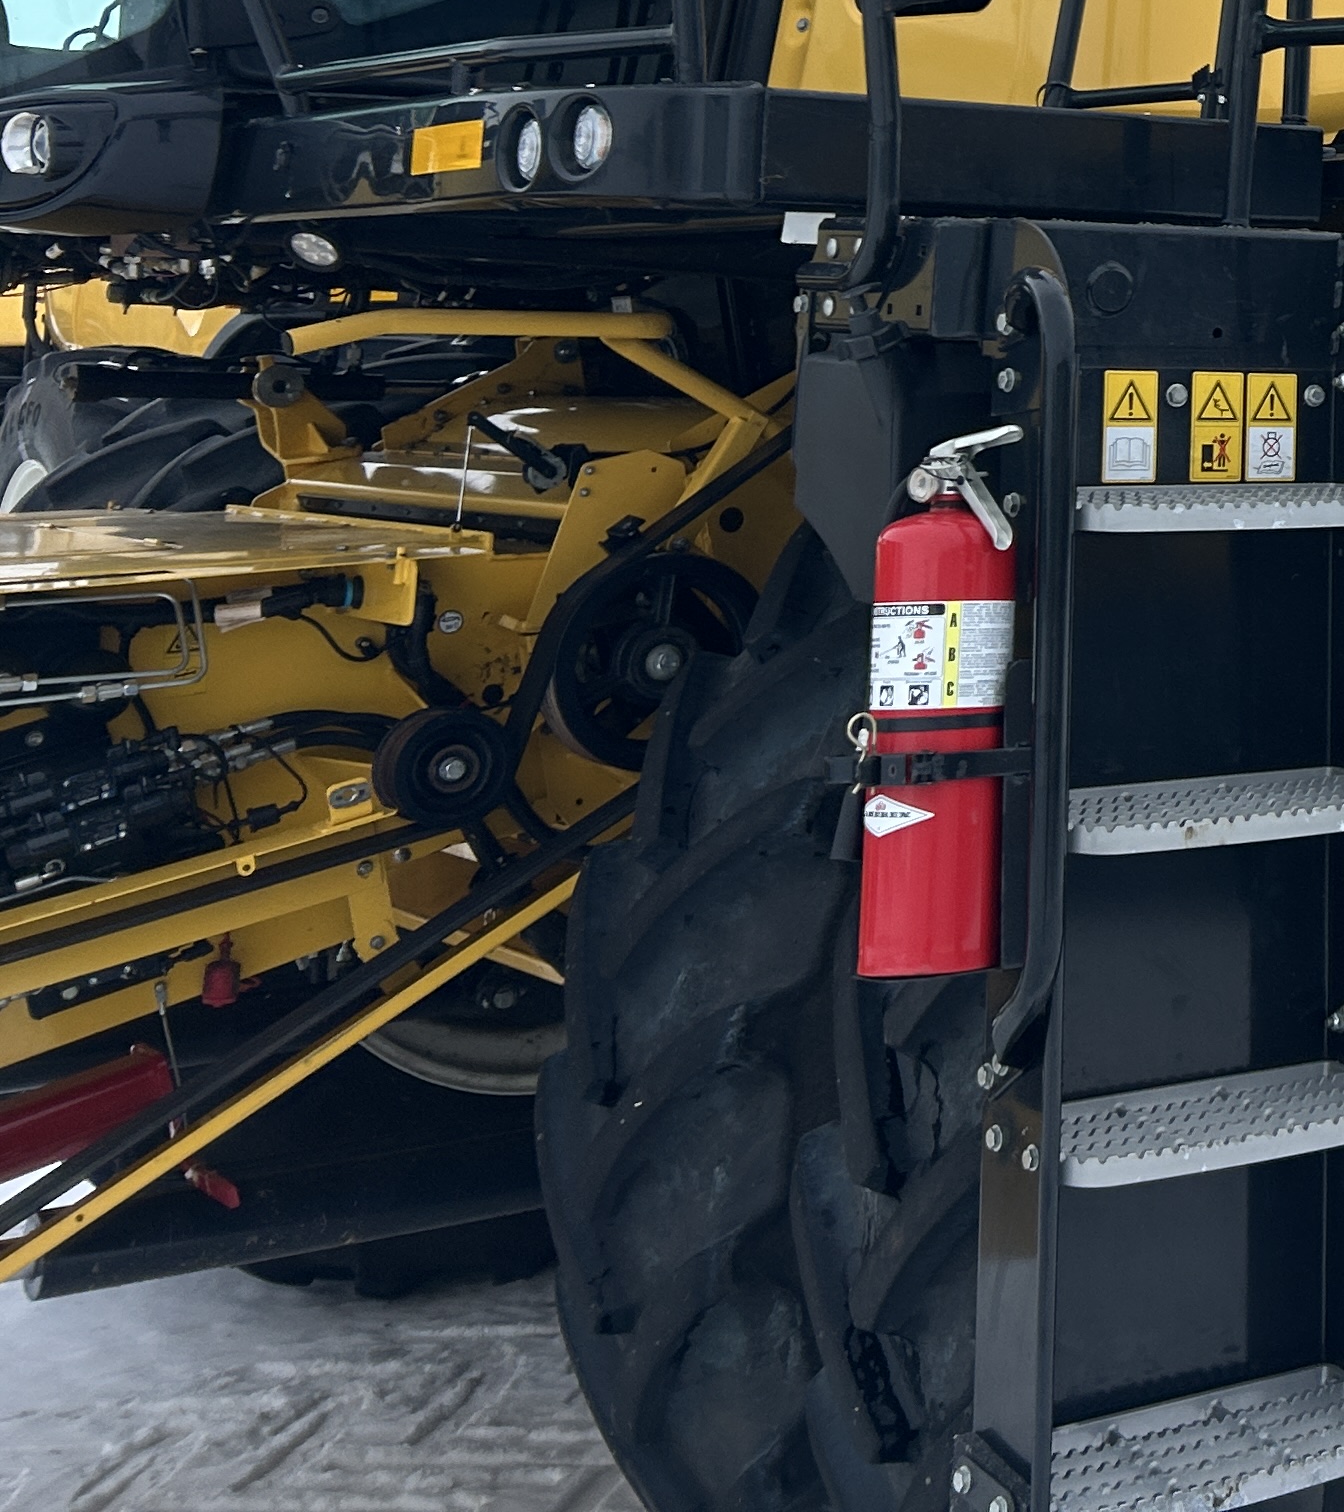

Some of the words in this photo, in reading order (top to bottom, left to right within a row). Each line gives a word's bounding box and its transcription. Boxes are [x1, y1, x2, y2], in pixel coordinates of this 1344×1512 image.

[949, 613, 958, 628] A
[948, 647, 956, 663] B
[946, 681, 954, 697] C
